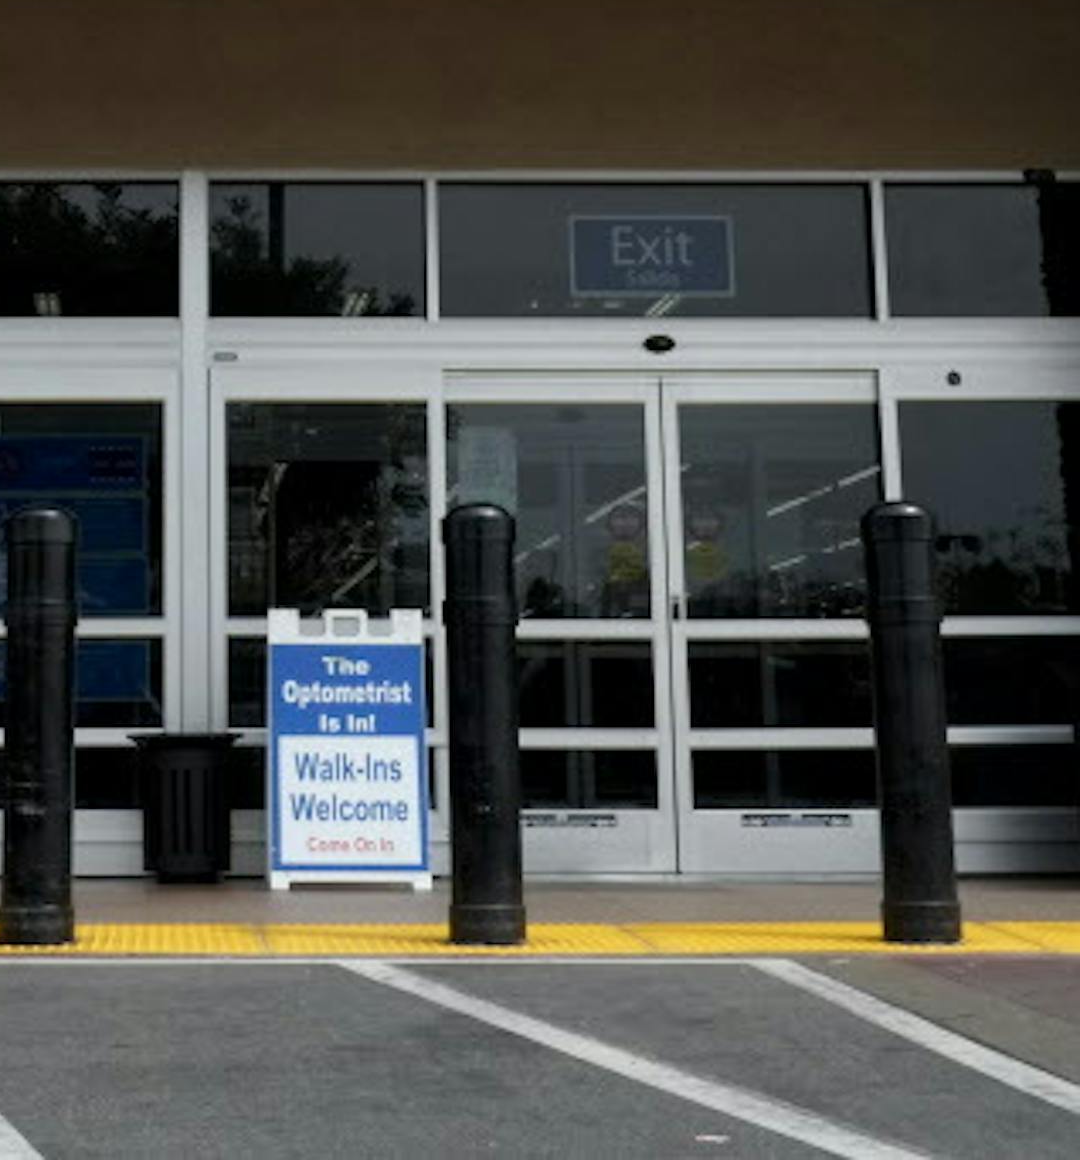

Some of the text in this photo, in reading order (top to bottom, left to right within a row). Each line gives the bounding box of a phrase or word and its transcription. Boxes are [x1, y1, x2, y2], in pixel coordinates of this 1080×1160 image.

[611, 225, 694, 266] Exit
[322, 656, 369, 676] The
[282, 679, 412, 708] Optometrist
[320, 714, 341, 733] Is
[295, 752, 402, 782] Walk-Ins
[289, 792, 409, 822] Welcome
[307, 836, 395, 853] Come On In
